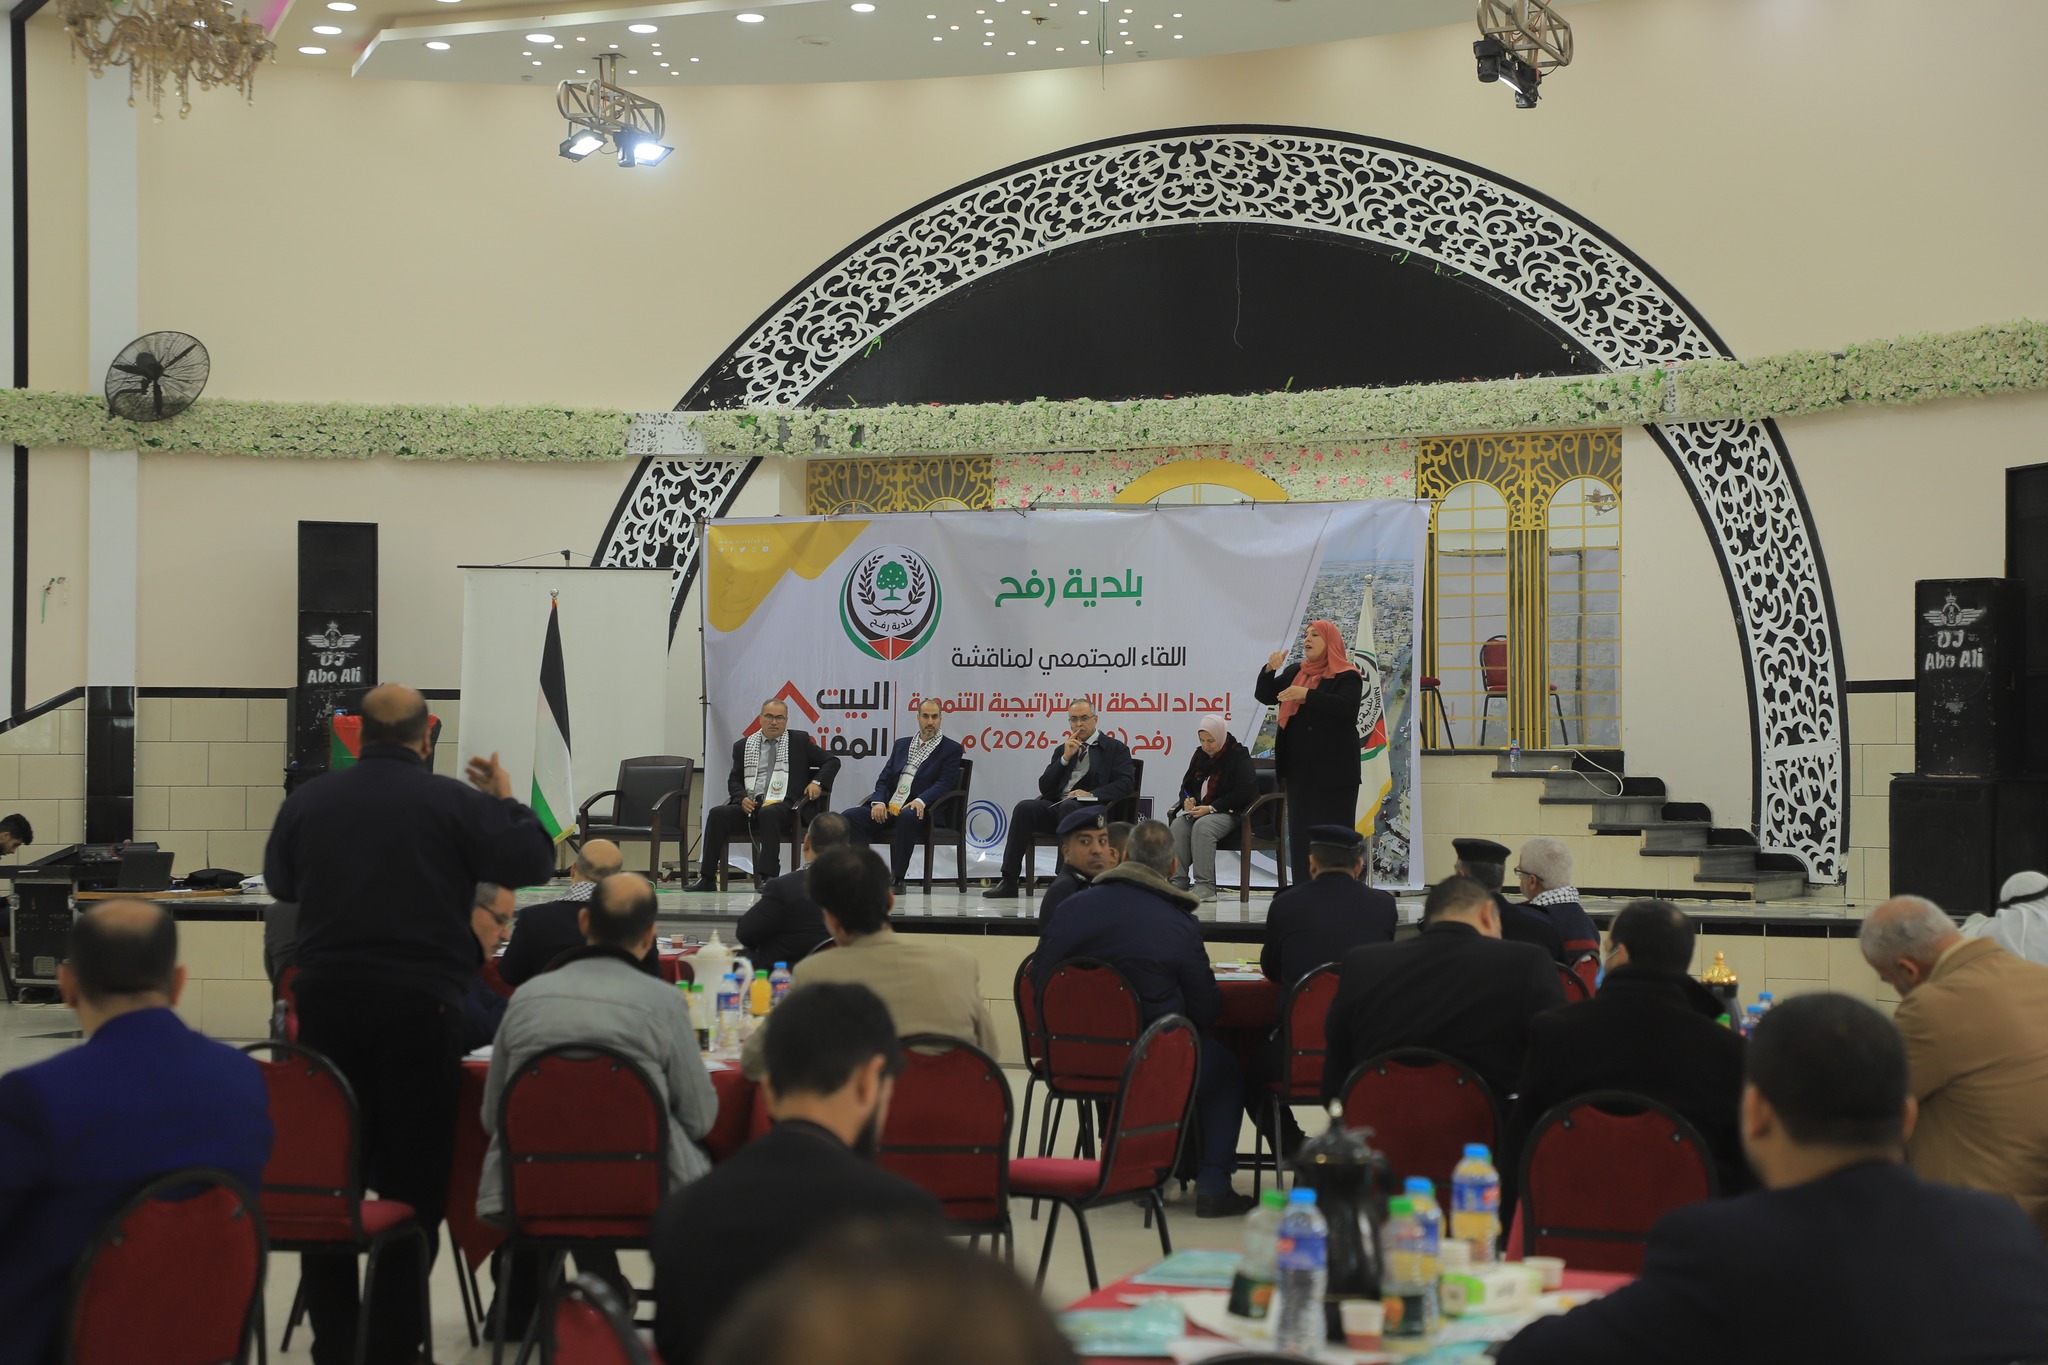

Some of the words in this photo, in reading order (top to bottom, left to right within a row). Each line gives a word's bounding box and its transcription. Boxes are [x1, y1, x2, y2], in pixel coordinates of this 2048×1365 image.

[995, 569, 1055, 608] رفح
[1063, 568, 1142, 607] بلدية
[870, 618, 890, 632] رفح
[892, 618, 914, 631] بلدية
[951, 645, 1033, 668] لمناقشة
[1039, 646, 1136, 676] المجتمعي
[1141, 646, 1186, 667] اللقاء
[1925, 651, 1956, 671] Abo
[1959, 647, 1983, 668] Ali
[307, 668, 338, 684] Abo
[340, 666, 361, 683] Ali
[816, 681, 889, 719] البيت
[1106, 692, 1168, 712] الخطة
[1172, 692, 1231, 720] إعداد
[1131, 730, 1172, 756] رفح
